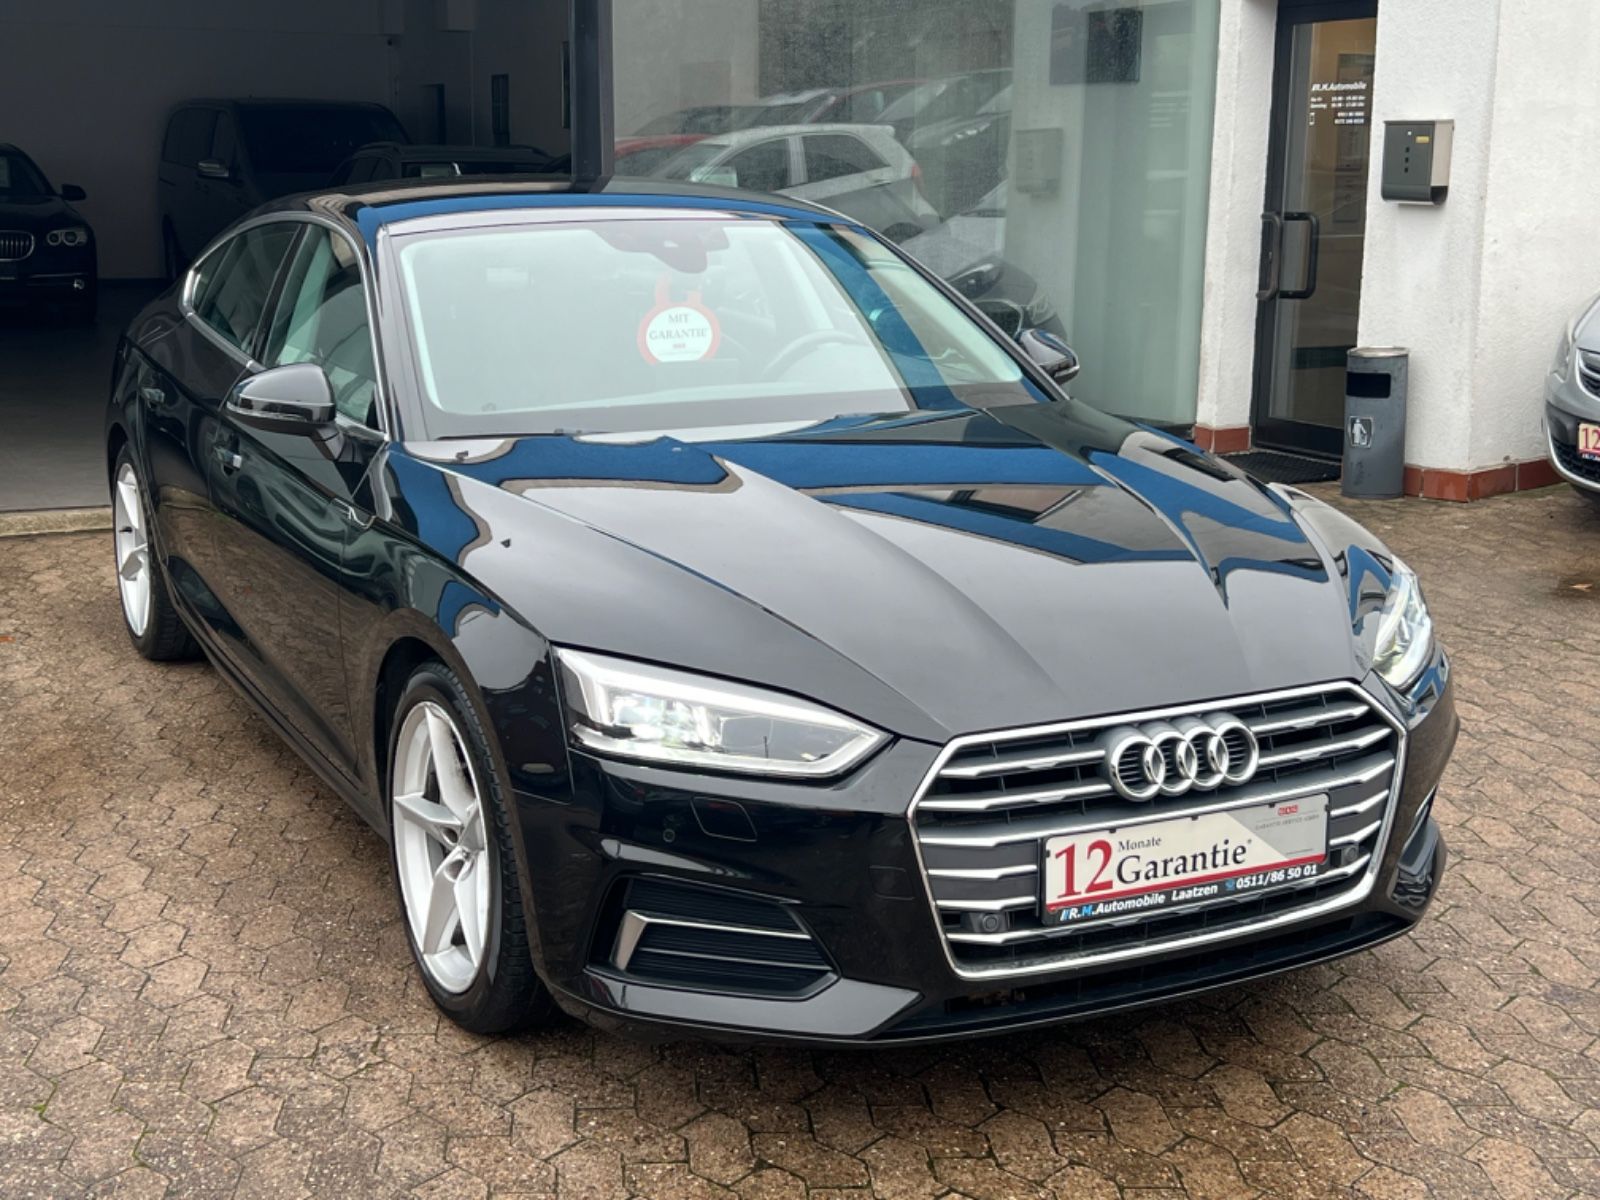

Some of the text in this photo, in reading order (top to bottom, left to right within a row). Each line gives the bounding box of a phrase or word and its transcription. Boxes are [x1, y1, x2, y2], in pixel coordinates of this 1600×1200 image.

[668, 313, 688, 324] MIT
[649, 328, 706, 340] GARANTIE
[1118, 835, 1162, 852] Monate
[1055, 839, 1113, 898] 12
[1172, 883, 1218, 901] Laatzen
[1236, 870, 1285, 889] 0511/86
[1303, 864, 1317, 875] 01
